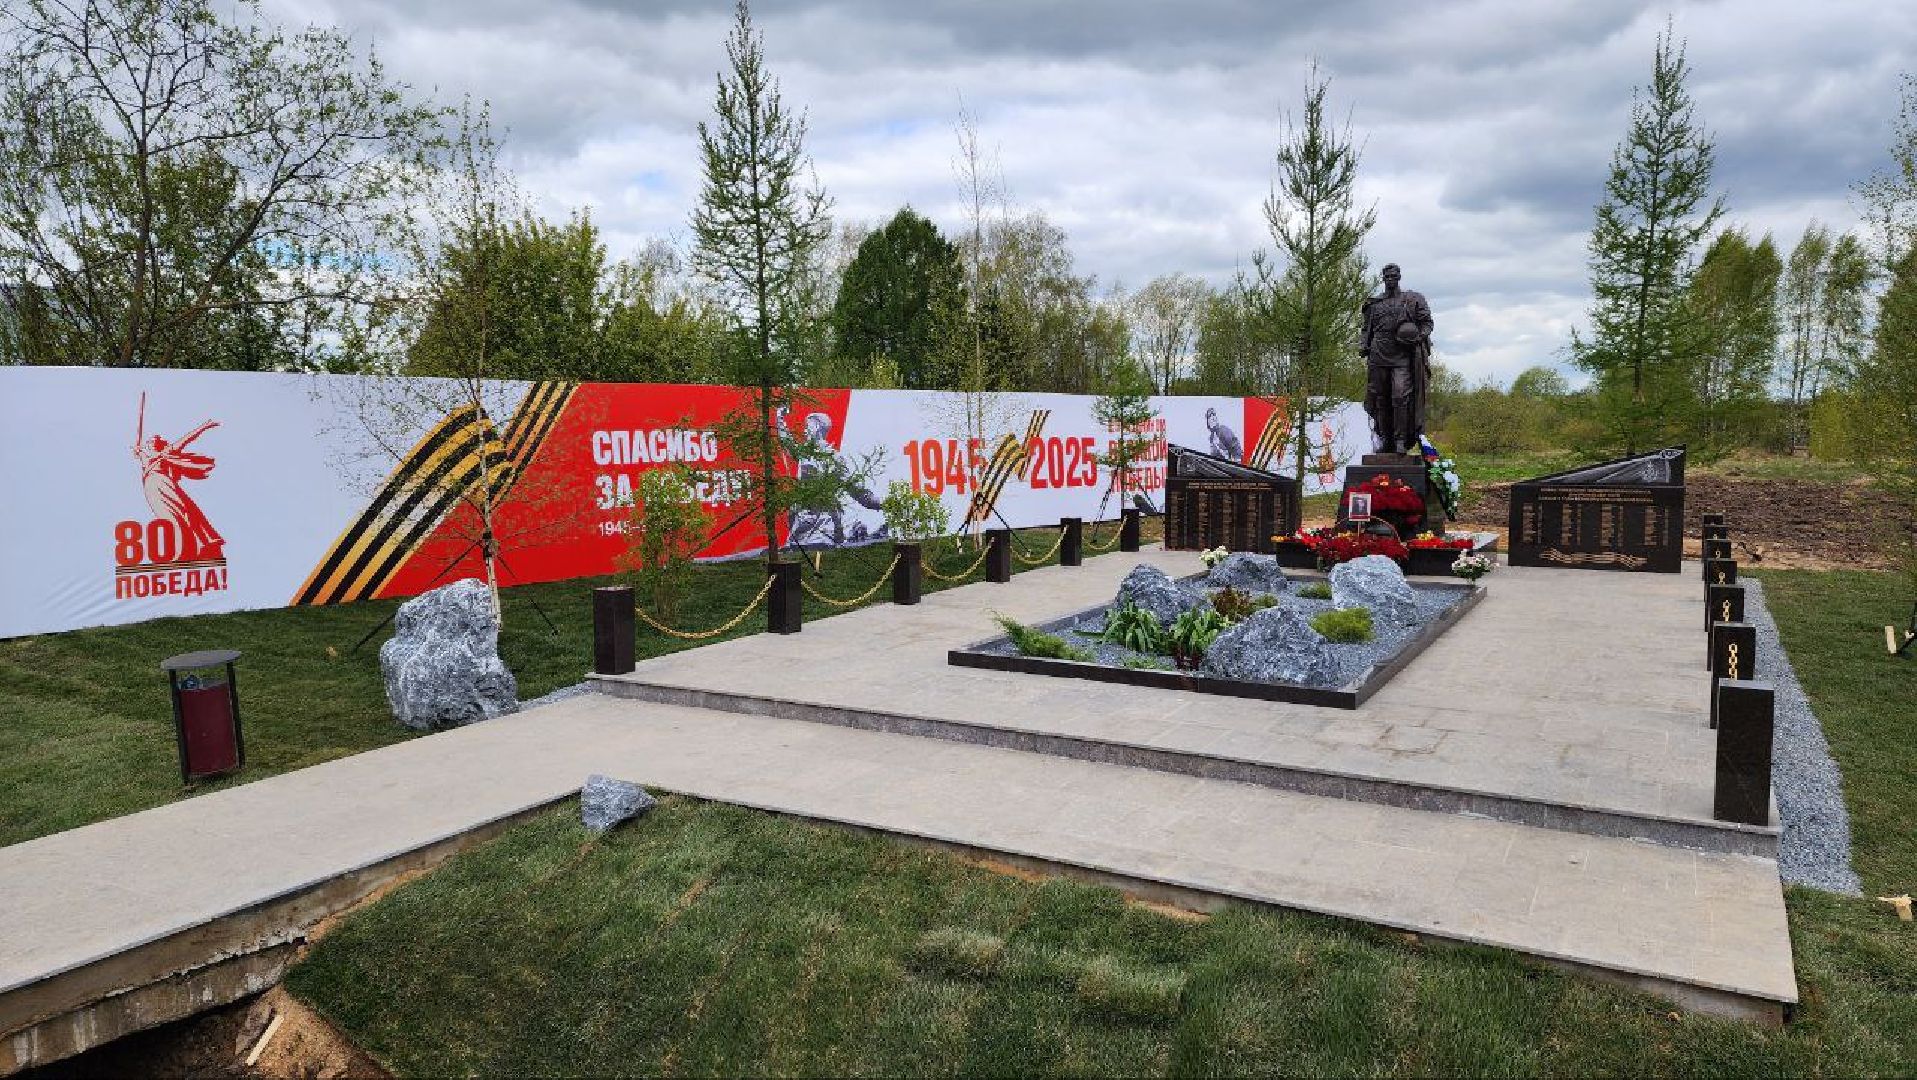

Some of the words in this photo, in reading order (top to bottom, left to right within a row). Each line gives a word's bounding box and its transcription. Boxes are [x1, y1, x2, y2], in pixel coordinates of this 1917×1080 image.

[592, 430, 718, 466] СПАСИБО
[903, 437, 987, 496] 1945
[1028, 436, 1098, 490] 2025
[595, 473, 635, 510] ЗА
[114, 519, 176, 566] 80
[115, 568, 228, 600] ПОБЕДА!
